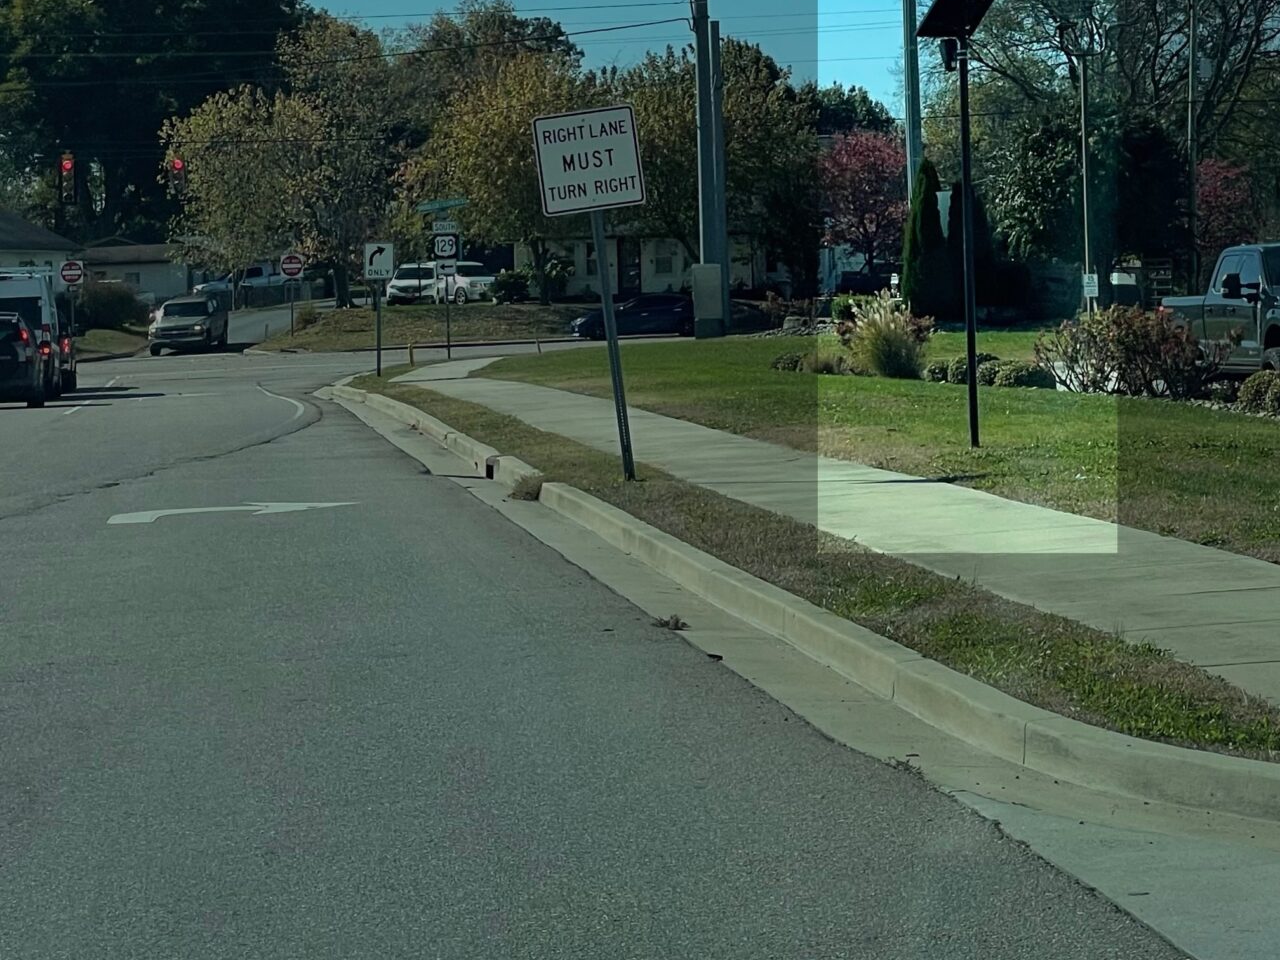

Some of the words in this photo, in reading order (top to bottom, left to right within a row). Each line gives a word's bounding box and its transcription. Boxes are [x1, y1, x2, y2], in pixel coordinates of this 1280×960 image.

[542, 125, 585, 145] RIGHT
[589, 120, 628, 139] LANE
[562, 148, 614, 173] MUST
[548, 183, 588, 201] TURN
[594, 175, 637, 195] RIGHT
[434, 223, 456, 232] SOUTH
[436, 239, 455, 253] 129
[367, 269, 391, 277] ONLY
